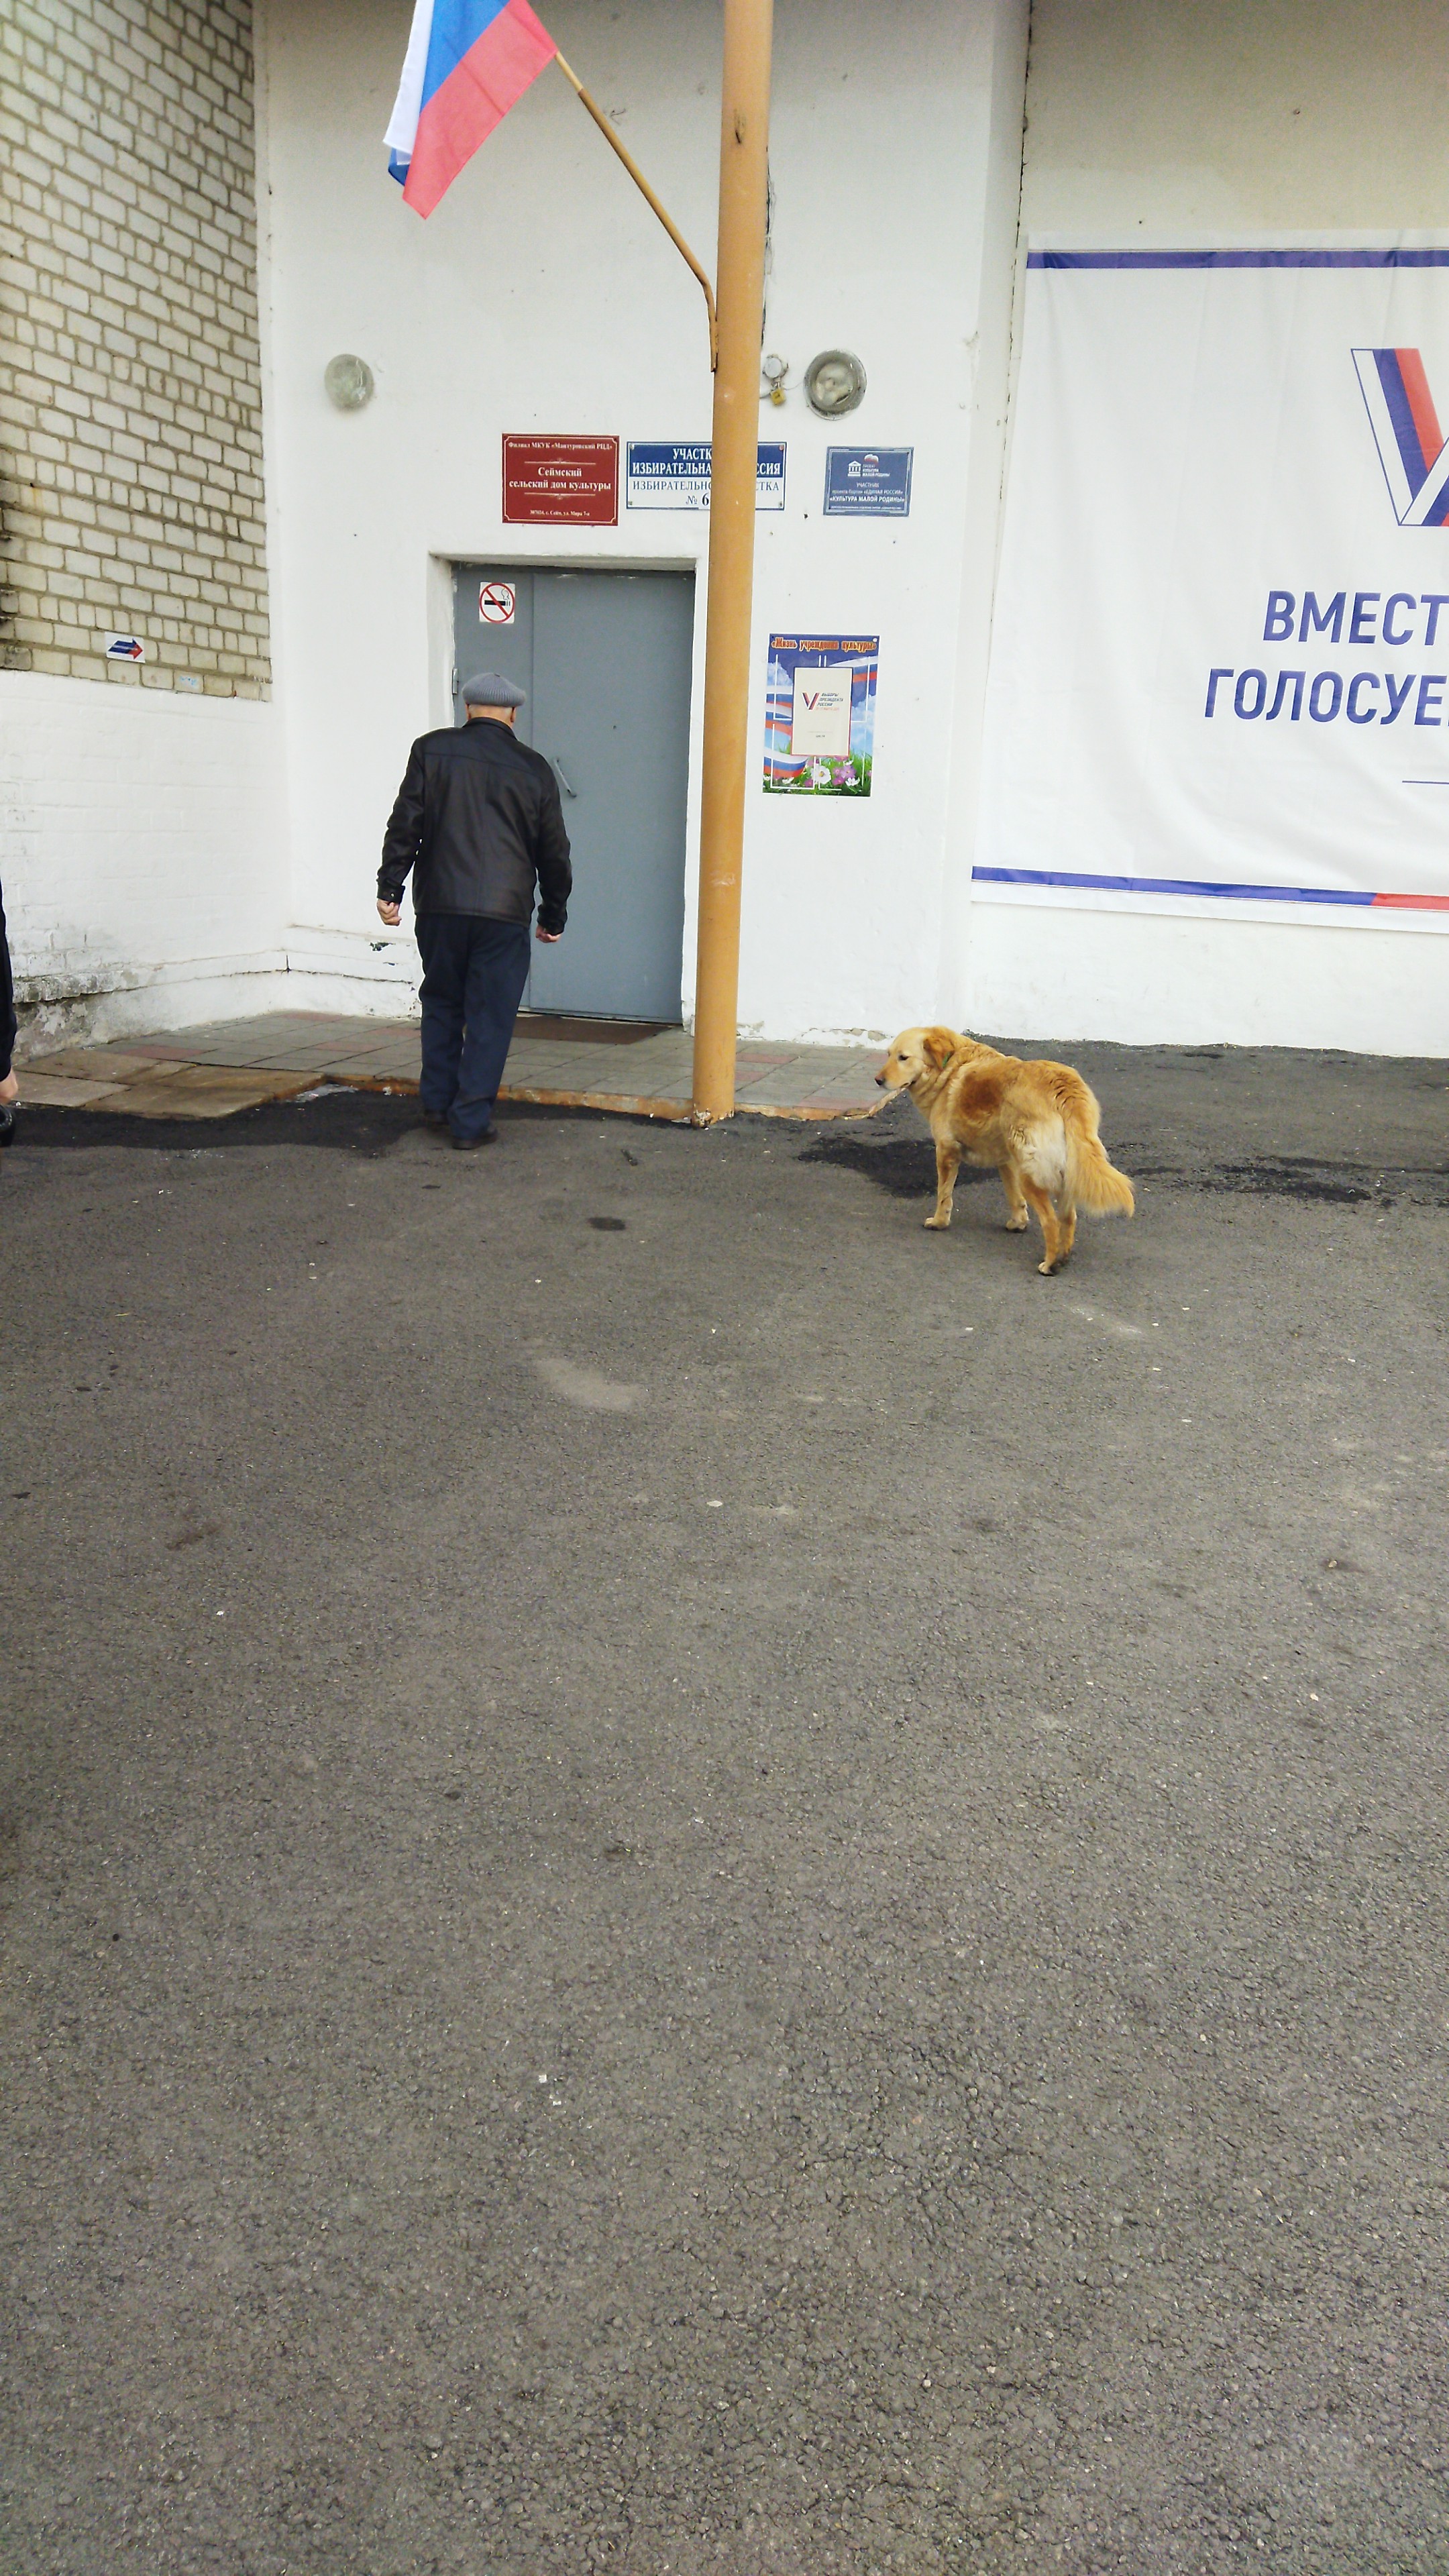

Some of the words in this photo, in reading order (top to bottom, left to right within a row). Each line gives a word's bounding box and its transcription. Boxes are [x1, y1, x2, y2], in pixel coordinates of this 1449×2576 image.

[673, 448, 712, 460] УЧАСТК
[538, 467, 582, 477] Сеймский
[633, 462, 712, 475] ИЗБИРАТЕЛЬНА
[508, 480, 549, 488] сельский
[550, 481, 567, 489] дом
[569, 482, 611, 492] культуры
[633, 480, 711, 490] ИЗБИРАТЕЛЬН
[686, 495, 698, 504] №
[1263, 590, 1449, 646] ВМЕСТ
[1204, 668, 1449, 727] ГОЛОСУЕ
